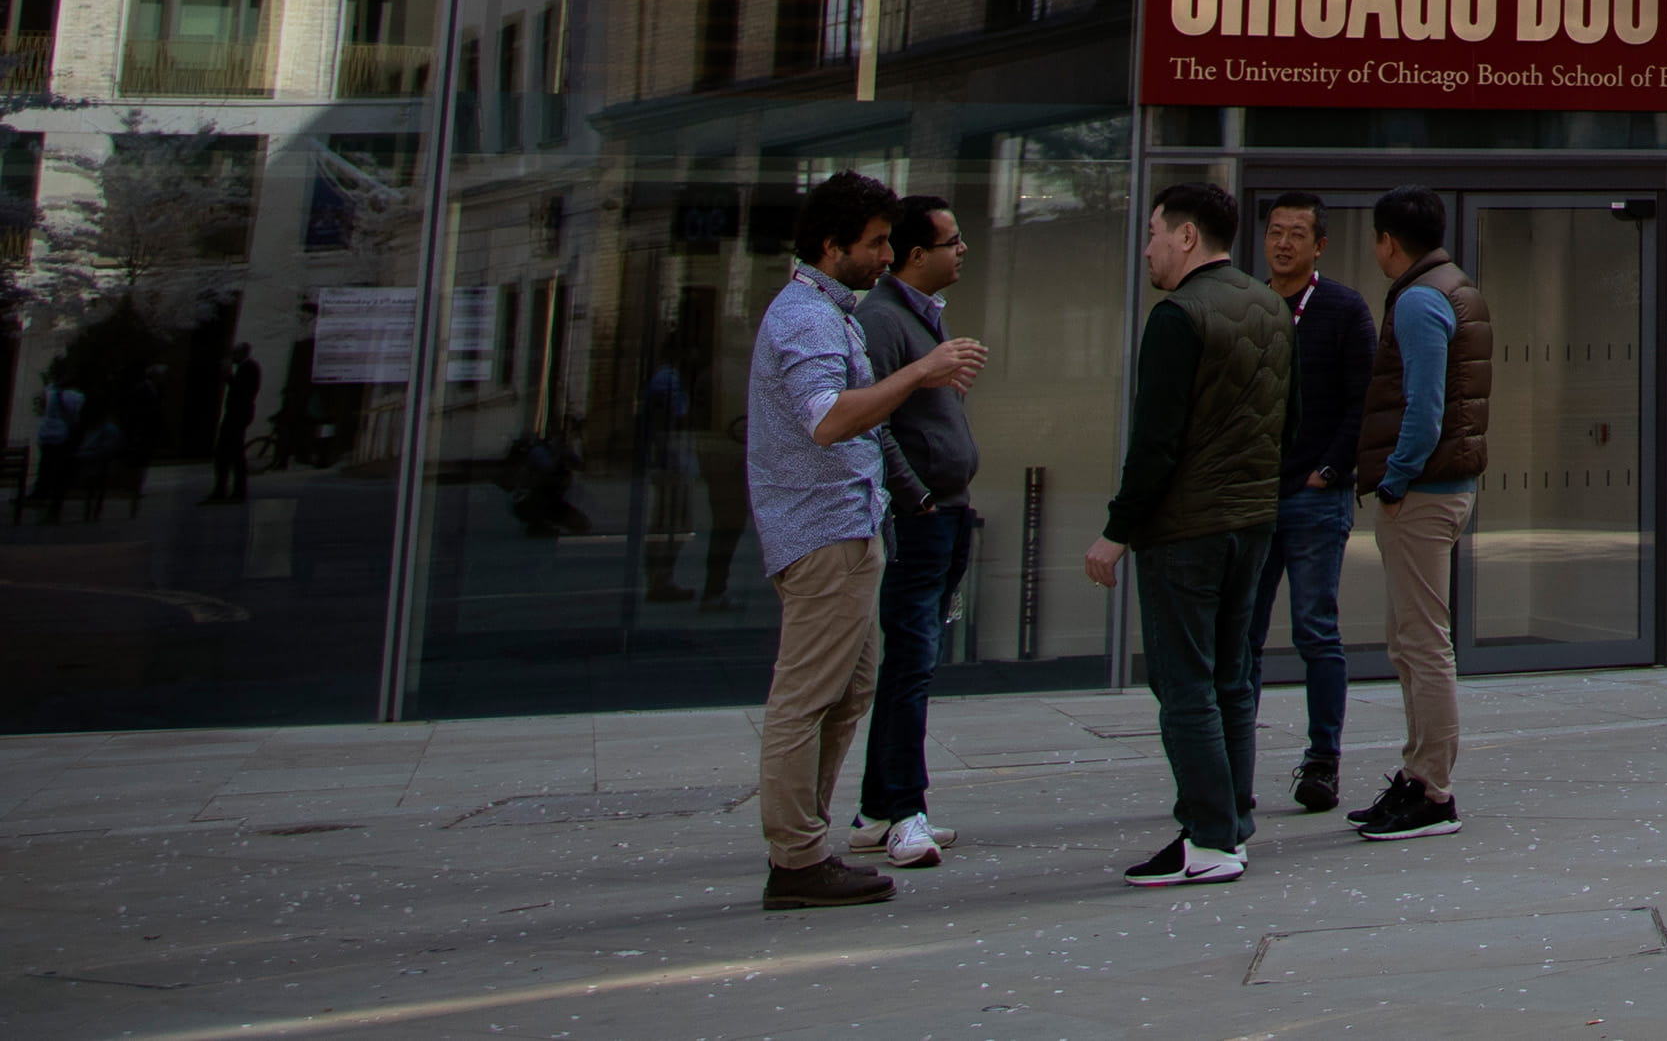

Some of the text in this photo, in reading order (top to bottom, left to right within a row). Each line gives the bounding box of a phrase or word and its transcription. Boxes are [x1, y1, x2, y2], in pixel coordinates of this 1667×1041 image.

[1170, 57, 1216, 80] The
[1225, 59, 1341, 89] University
[1348, 61, 1375, 83] of
[1378, 62, 1469, 92] Chicago
[1478, 64, 1544, 85] Booth
[1552, 65, 1623, 86] School
[1631, 65, 1655, 87] of
